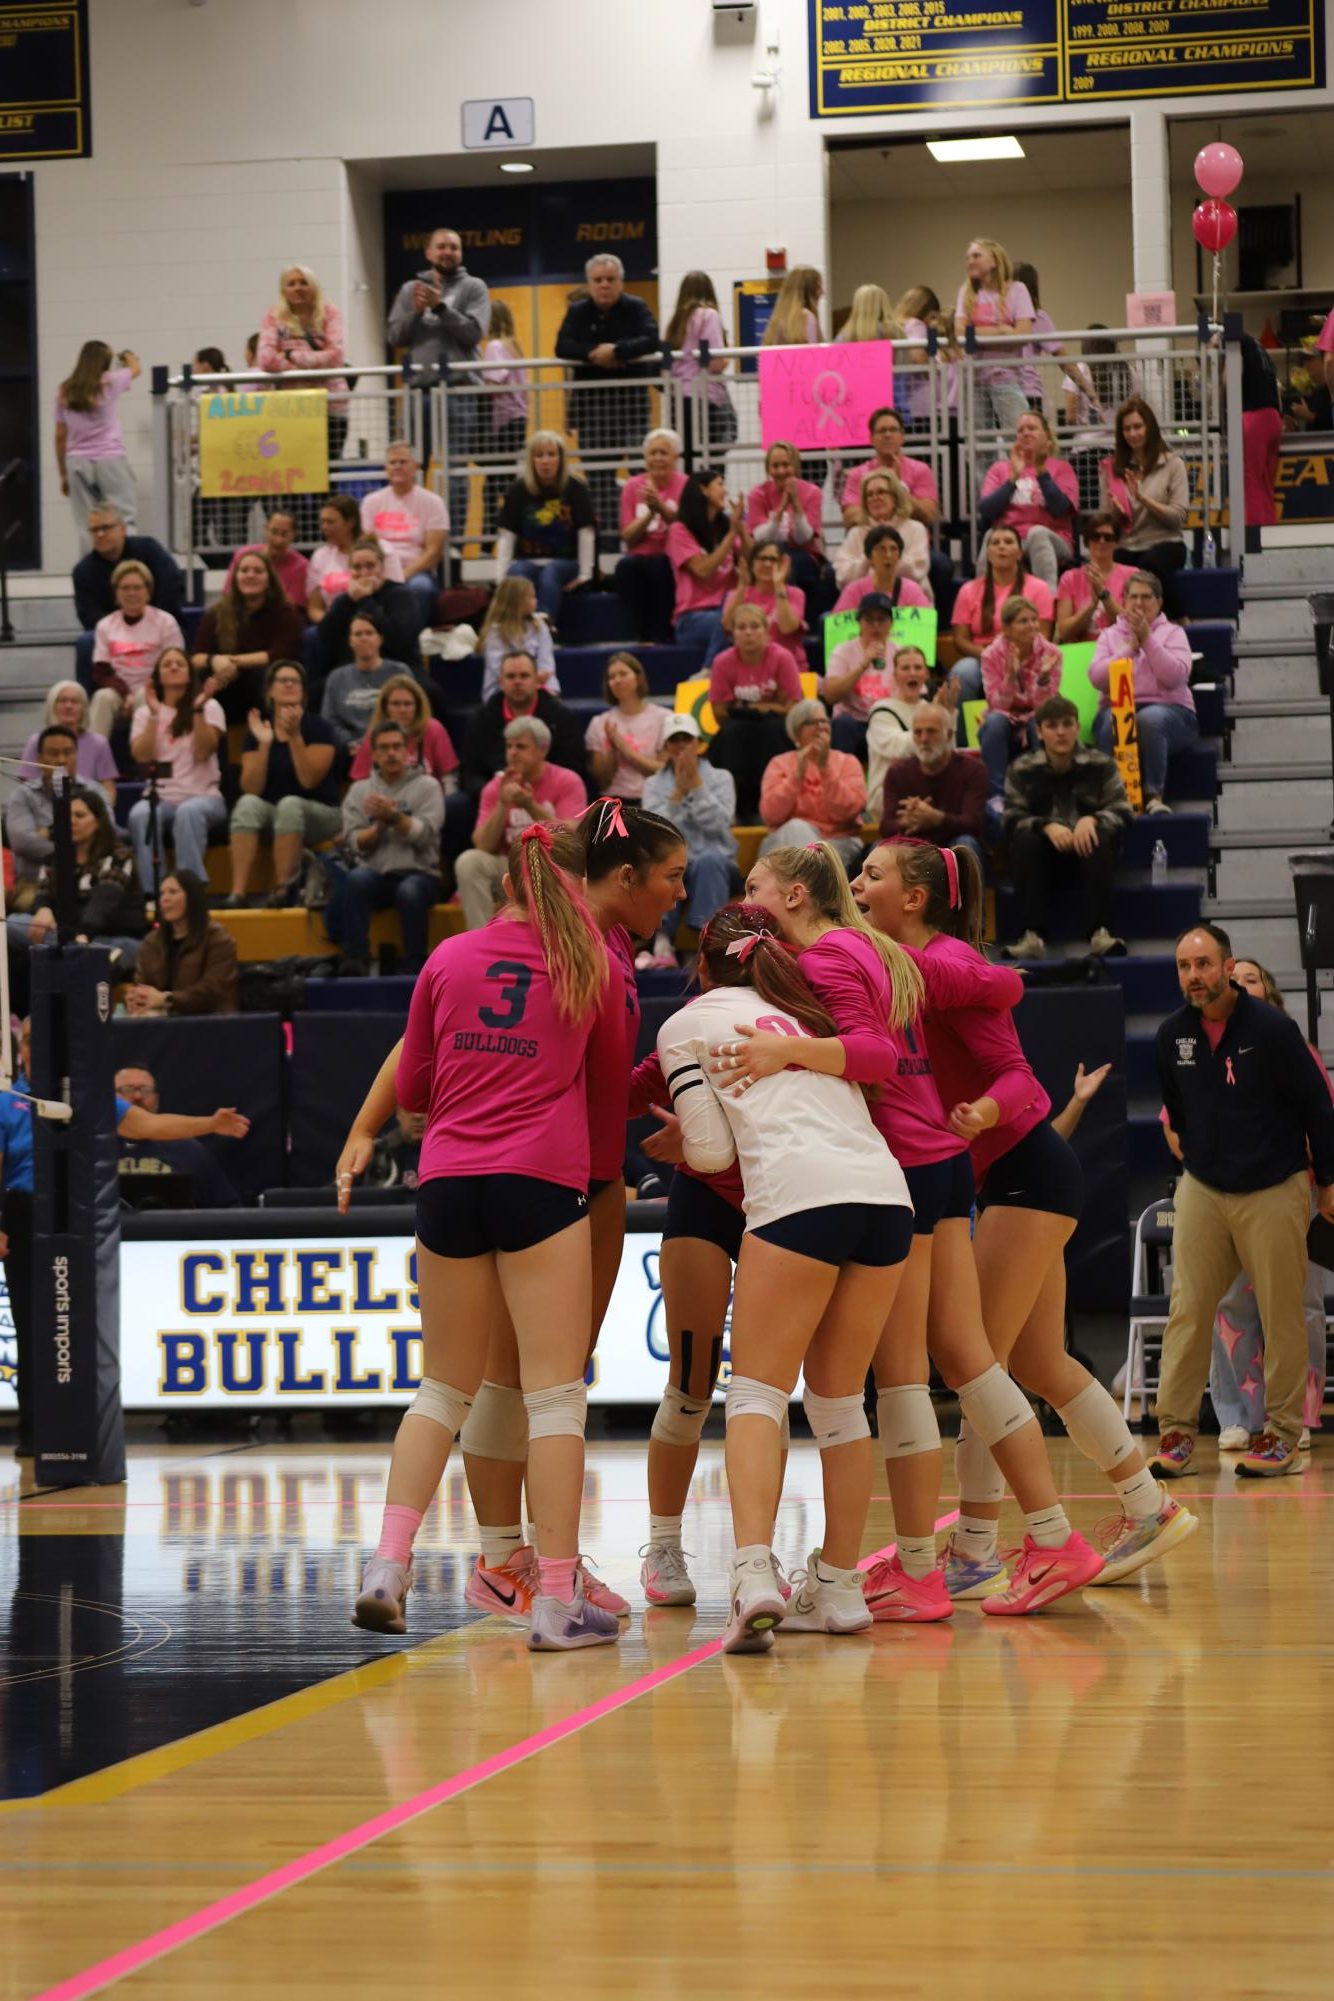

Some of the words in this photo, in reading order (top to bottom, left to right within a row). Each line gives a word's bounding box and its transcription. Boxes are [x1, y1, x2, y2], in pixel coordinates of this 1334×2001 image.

[1107, 0, 1174, 15] DISTRICT
[0, 17, 69, 29] HAMPIONS
[863, 17, 930, 31] DISTRICT
[933, 11, 1023, 27] CHAMPIONS
[1086, 48, 1177, 66] REGIONAL
[1184, 41, 1294, 59] CHAMPIONS
[839, 66, 929, 82] REGIONAL
[935, 58, 1044, 77] CHAMPIONS
[484, 104, 514, 140] A
[576, 222, 645, 242] ROOM
[208, 395, 265, 419] ALLY
[478, 960, 532, 1029] 3
[453, 1032, 538, 1058] BULLDOGS
[52, 1256, 71, 1312] sports
[53, 1314, 72, 1384] imports
